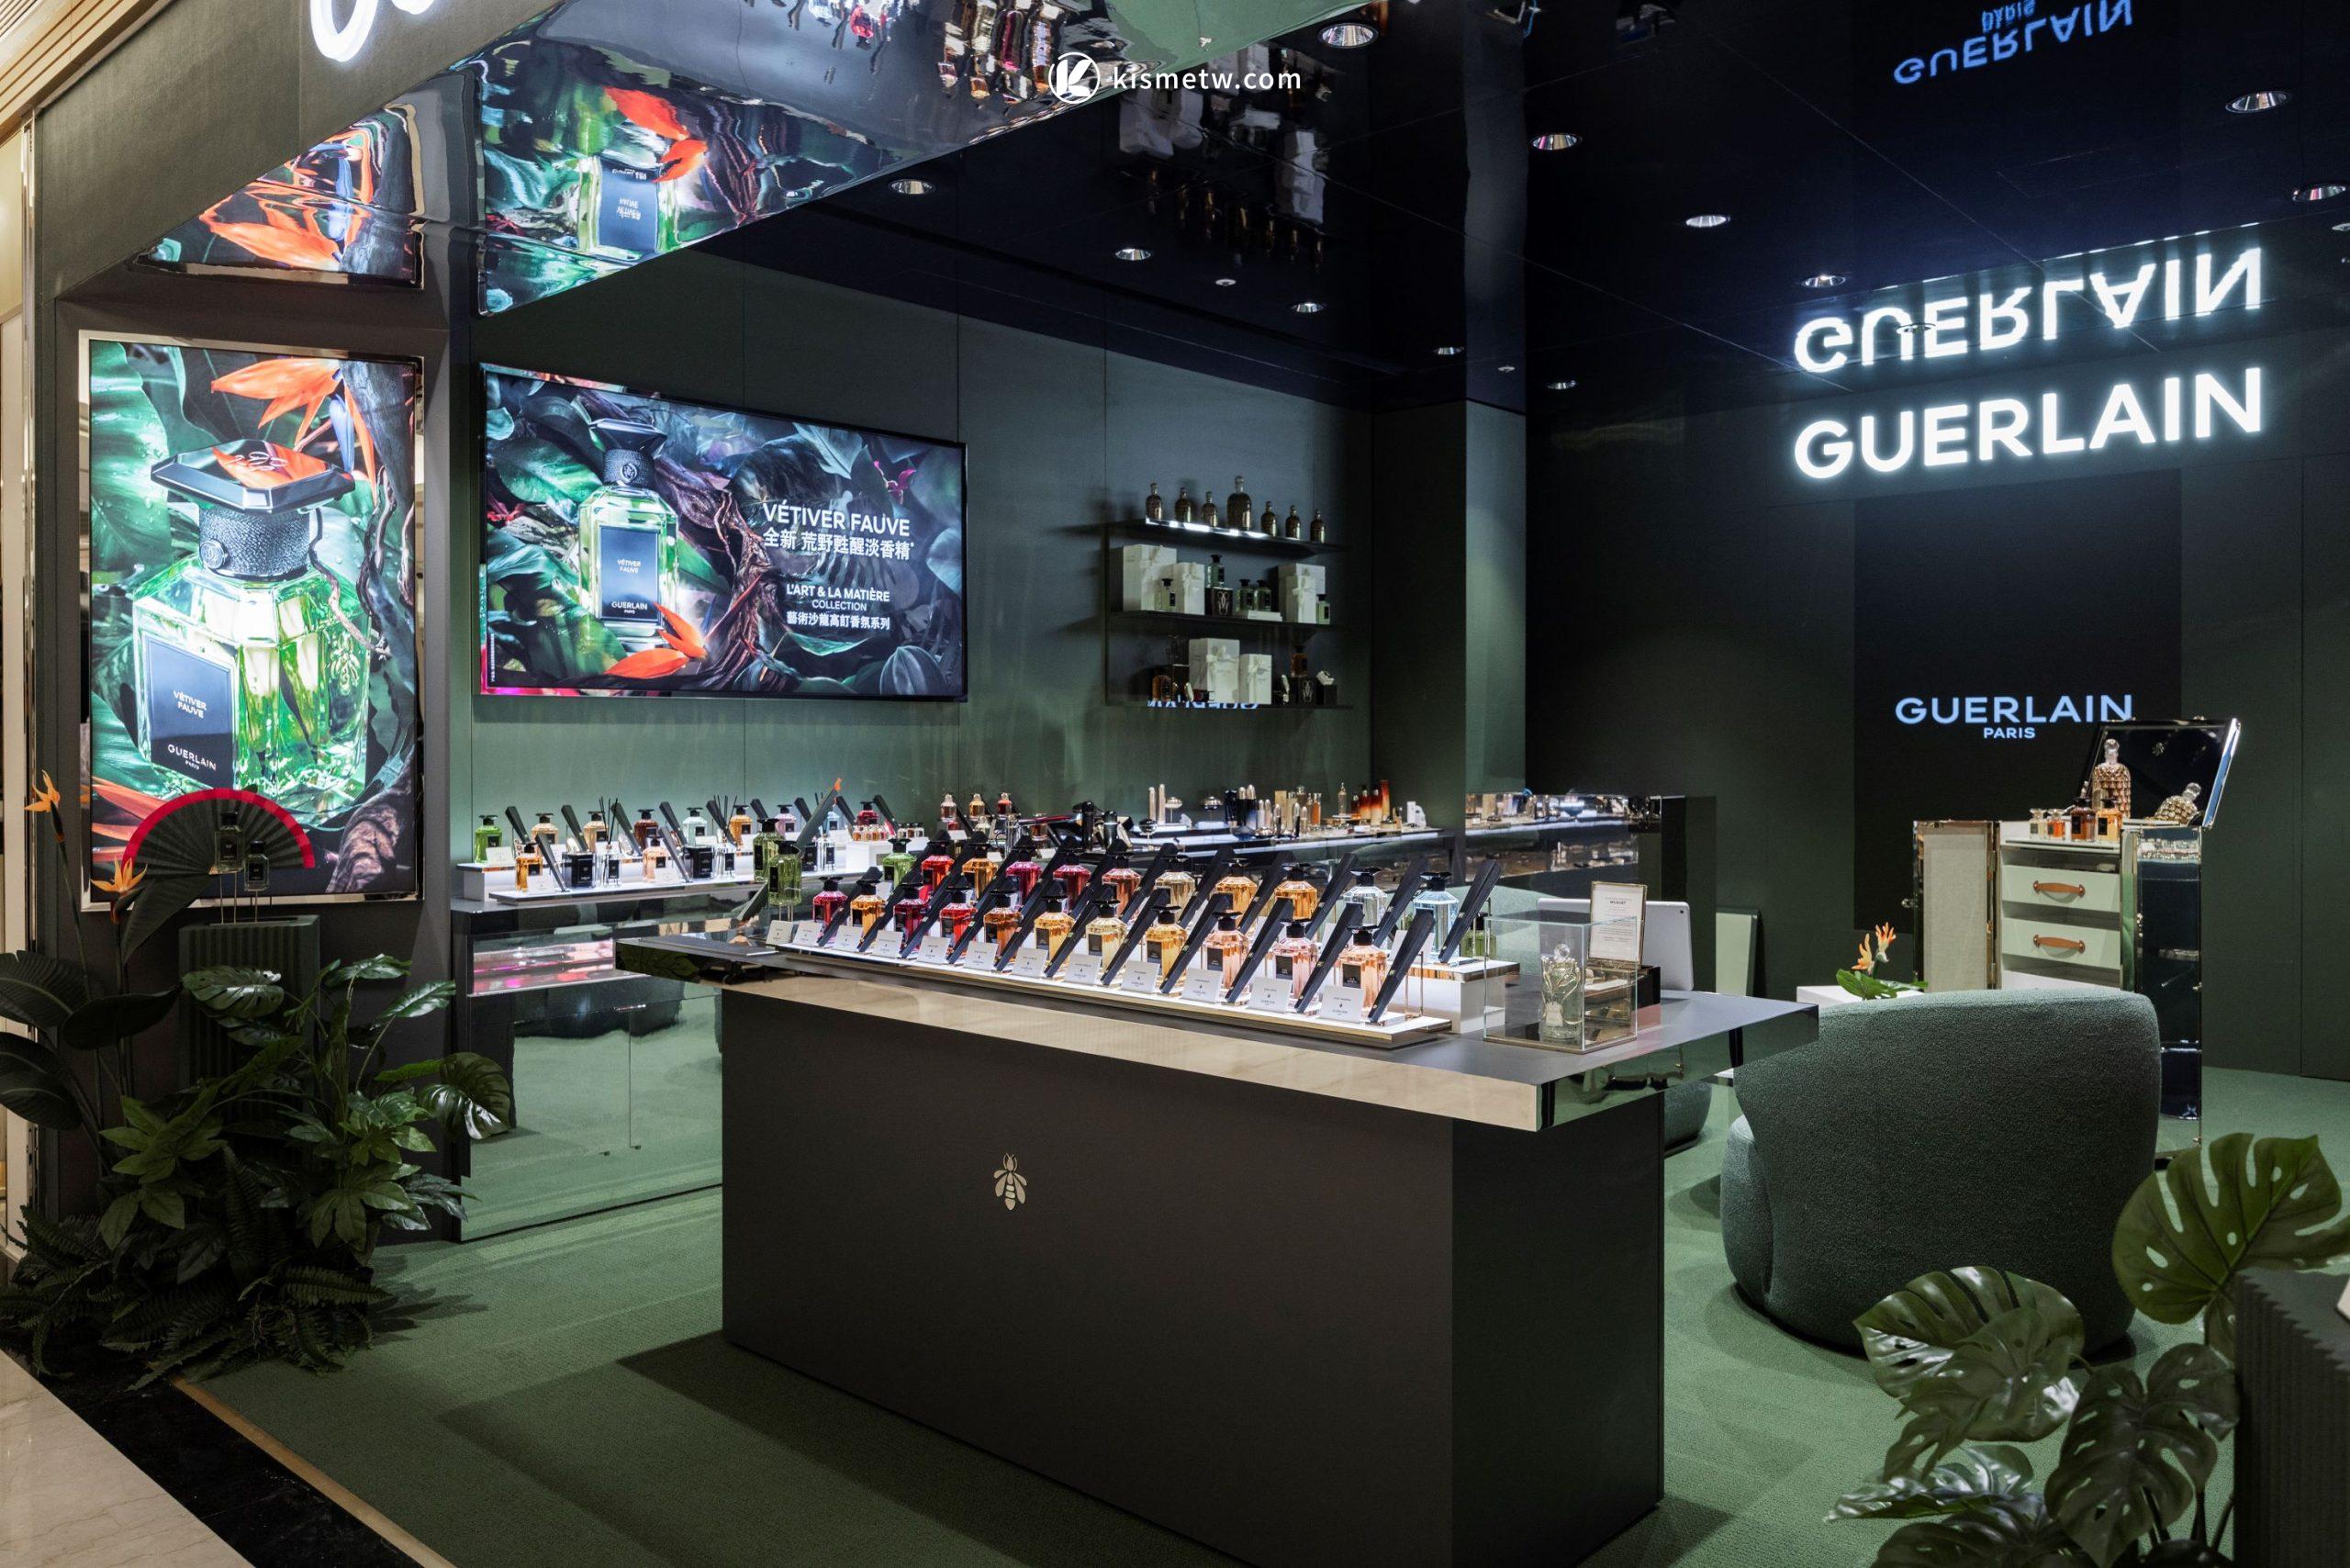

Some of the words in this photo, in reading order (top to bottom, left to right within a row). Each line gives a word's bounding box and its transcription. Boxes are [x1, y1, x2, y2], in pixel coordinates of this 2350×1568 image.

[1795, 367, 2261, 479] GUERLAIN
[762, 499, 845, 530] VÉTIVER
[851, 512, 911, 536] FAUVE
[762, 527, 797, 550] 全新
[786, 584, 816, 598] L'ART
[817, 587, 825, 598] &
[828, 588, 842, 599] LA
[844, 588, 890, 602] MATIÈRE
[611, 601, 648, 610] GUERLAIN
[811, 599, 867, 612] COLLECTION
[173, 689, 207, 711] VÉTIVER
[177, 700, 204, 719] FAUVE
[1896, 694, 2132, 724] GUERLAIN
[1983, 727, 2036, 739] PARIS
[167, 744, 217, 771] GUERLAIN
